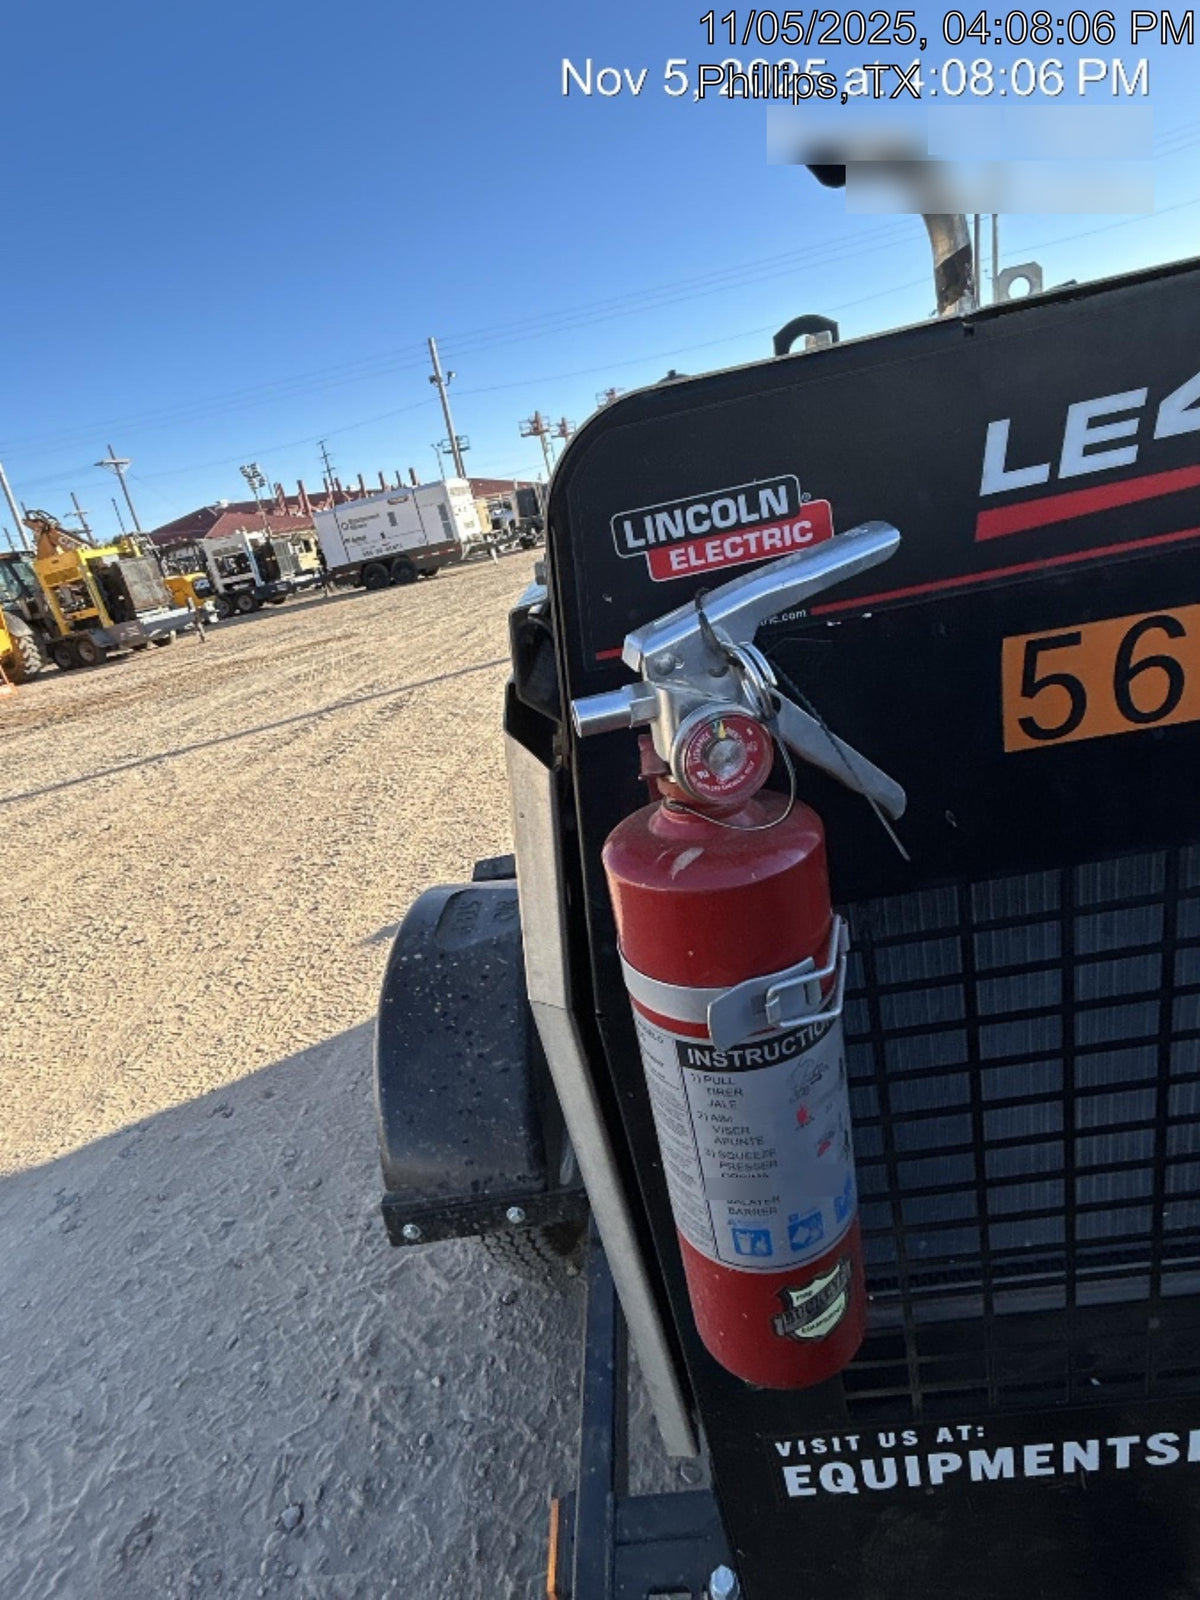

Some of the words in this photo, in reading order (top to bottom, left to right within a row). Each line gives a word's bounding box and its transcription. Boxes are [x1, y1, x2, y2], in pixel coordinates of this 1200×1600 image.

[622, 485, 790, 549] LINCOLN
[669, 520, 814, 571] ELECTRIC
[1016, 614, 1187, 741] 56
[774, 1434, 861, 1457] VISIT
[878, 1429, 919, 1449] US
[936, 1424, 985, 1444] AT:
